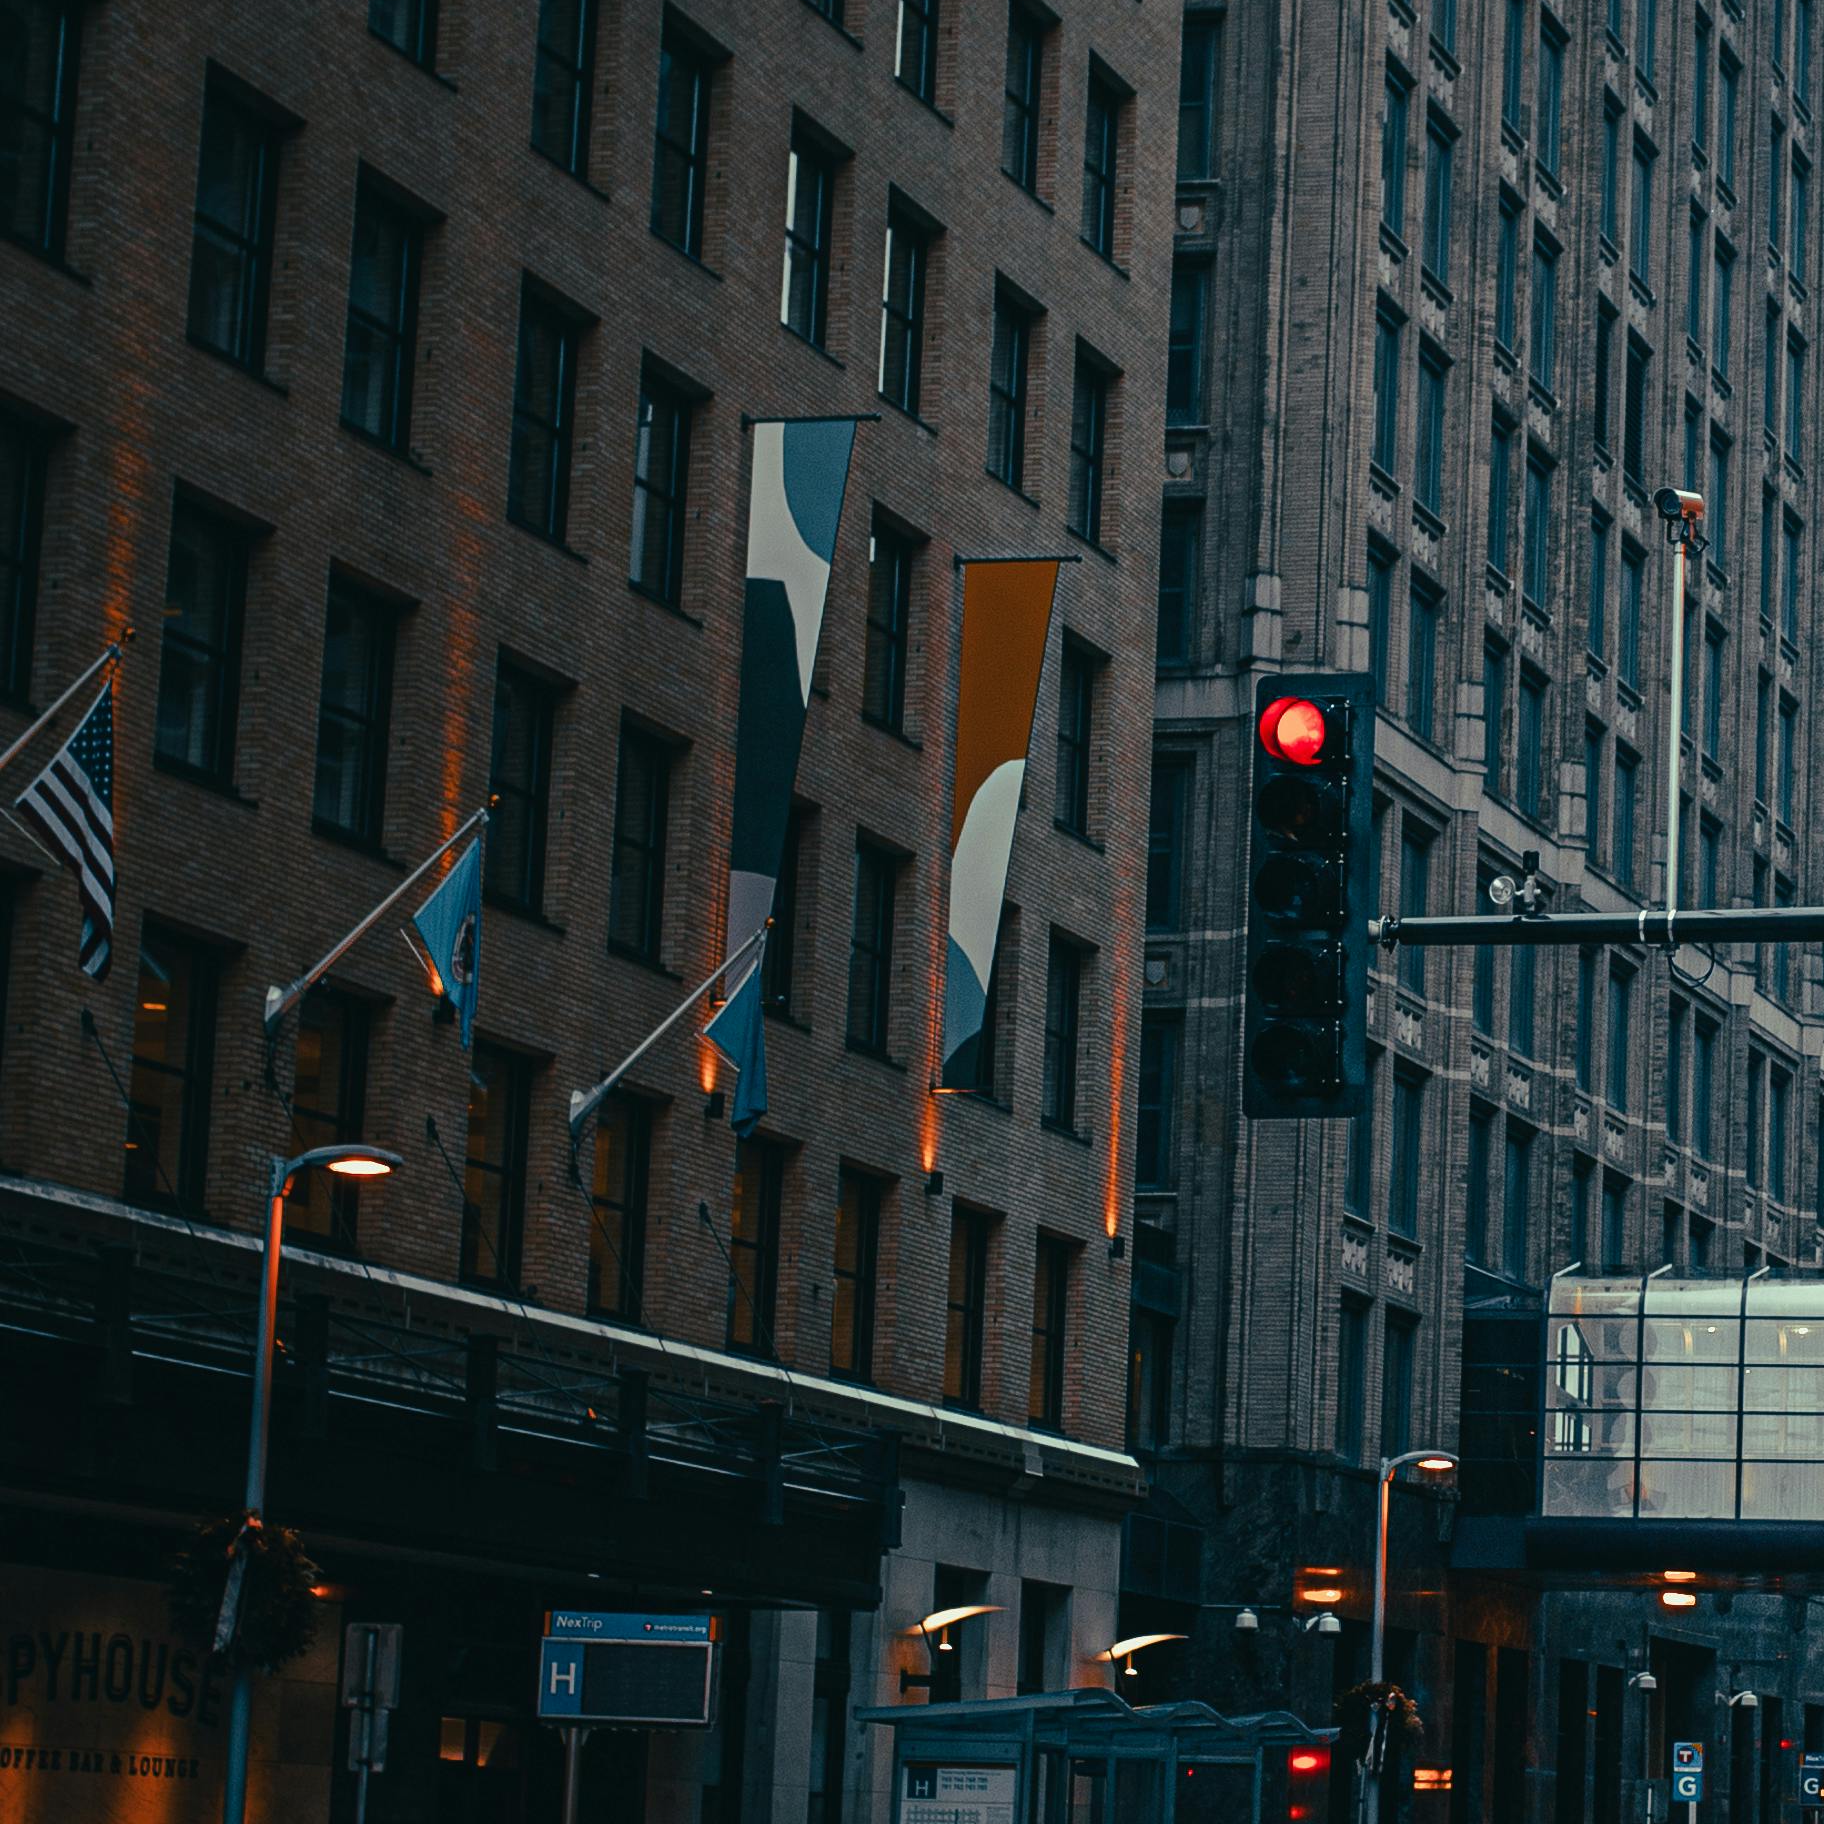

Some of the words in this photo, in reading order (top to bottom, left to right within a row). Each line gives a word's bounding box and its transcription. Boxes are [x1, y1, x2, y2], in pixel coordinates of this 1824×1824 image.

[556, 1616, 604, 1632] NexTrip
[0, 1632, 224, 1728] PYHOUSE
[549, 1661, 576, 1695] H
[69, 1751, 103, 1773] BAR
[129, 1755, 200, 1778] LOUNGE
[915, 1779, 929, 1797] H
[1678, 1776, 1697, 1797] G
[1804, 1778, 1819, 1795] G
